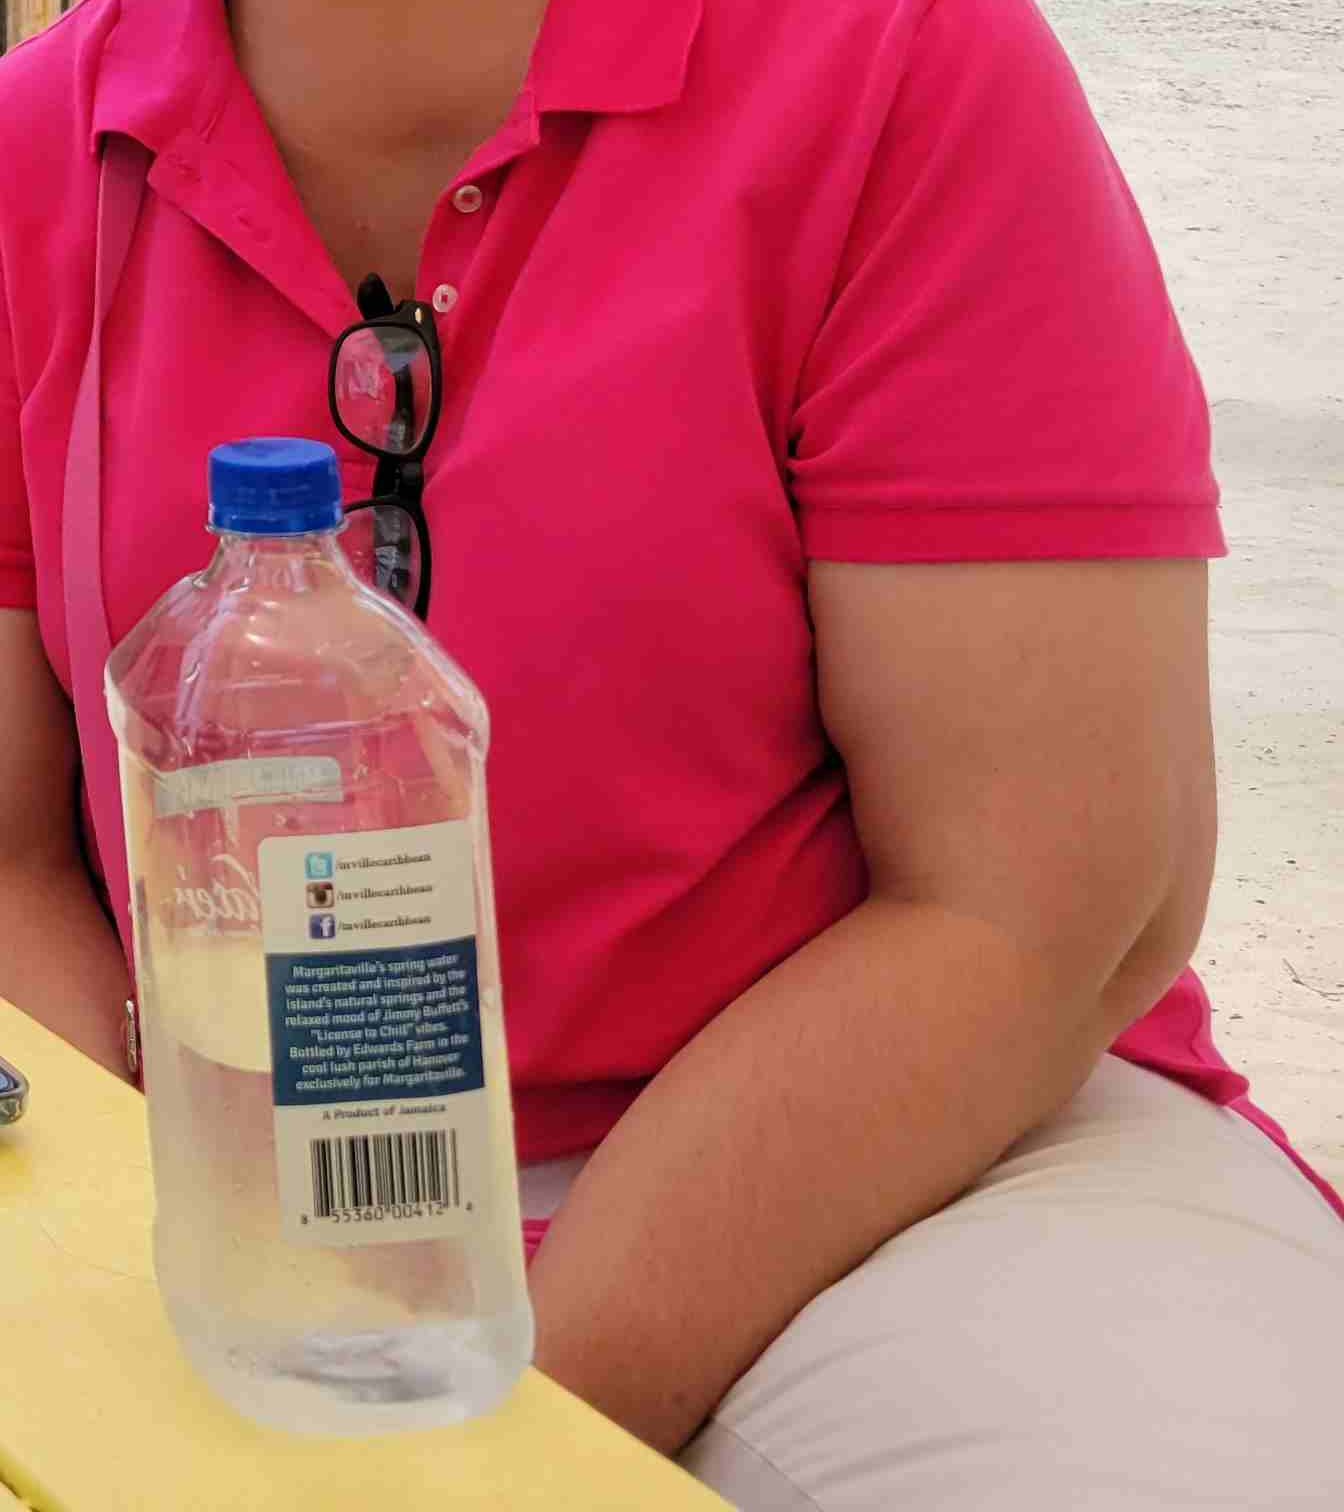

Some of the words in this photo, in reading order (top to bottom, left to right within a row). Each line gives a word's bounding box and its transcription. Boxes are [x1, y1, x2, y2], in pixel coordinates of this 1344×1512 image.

[293, 961, 386, 979] Margaritaville's
[388, 958, 425, 974] spring
[427, 952, 459, 967] water
[285, 984, 310, 994] was
[312, 980, 355, 993] created
[358, 977, 381, 990] and
[383, 974, 431, 990] inspired
[433, 972, 446, 986] by
[447, 969, 466, 982] the
[335, 993, 377, 1008] natural
[380, 990, 424, 1006] springs
[426, 988, 447, 999] and
[448, 985, 466, 997] the
[285, 1014, 330, 1028] relaxed
[332, 1011, 365, 1024] mood
[367, 1009, 382, 1022] of
[382, 1006, 420, 1023] Jimmy
[422, 1001, 469, 1018] Buffett's
[365, 1027, 377, 1039] to
[289, 1045, 334, 1059] Bottled
[336, 1044, 351, 1059] by
[353, 1041, 405, 1055] Edwards
[406, 1039, 436, 1051] Farm
[437, 1037, 449, 1049] in
[450, 1033, 469, 1045] the
[302, 1062, 328, 1073] cool
[330, 1059, 355, 1072] lush
[358, 1058, 396, 1073] parish
[397, 1055, 412, 1068] of
[413, 1052, 460, 1066] Hanover
[296, 1076, 362, 1091] exclusively
[363, 1073, 382, 1086] for
[322, 1110, 332, 1121] A
[333, 1107, 380, 1120] Product
[382, 1105, 396, 1116] of
[399, 1102, 446, 1116] Jamaica
[330, 1207, 385, 1224] 55360
